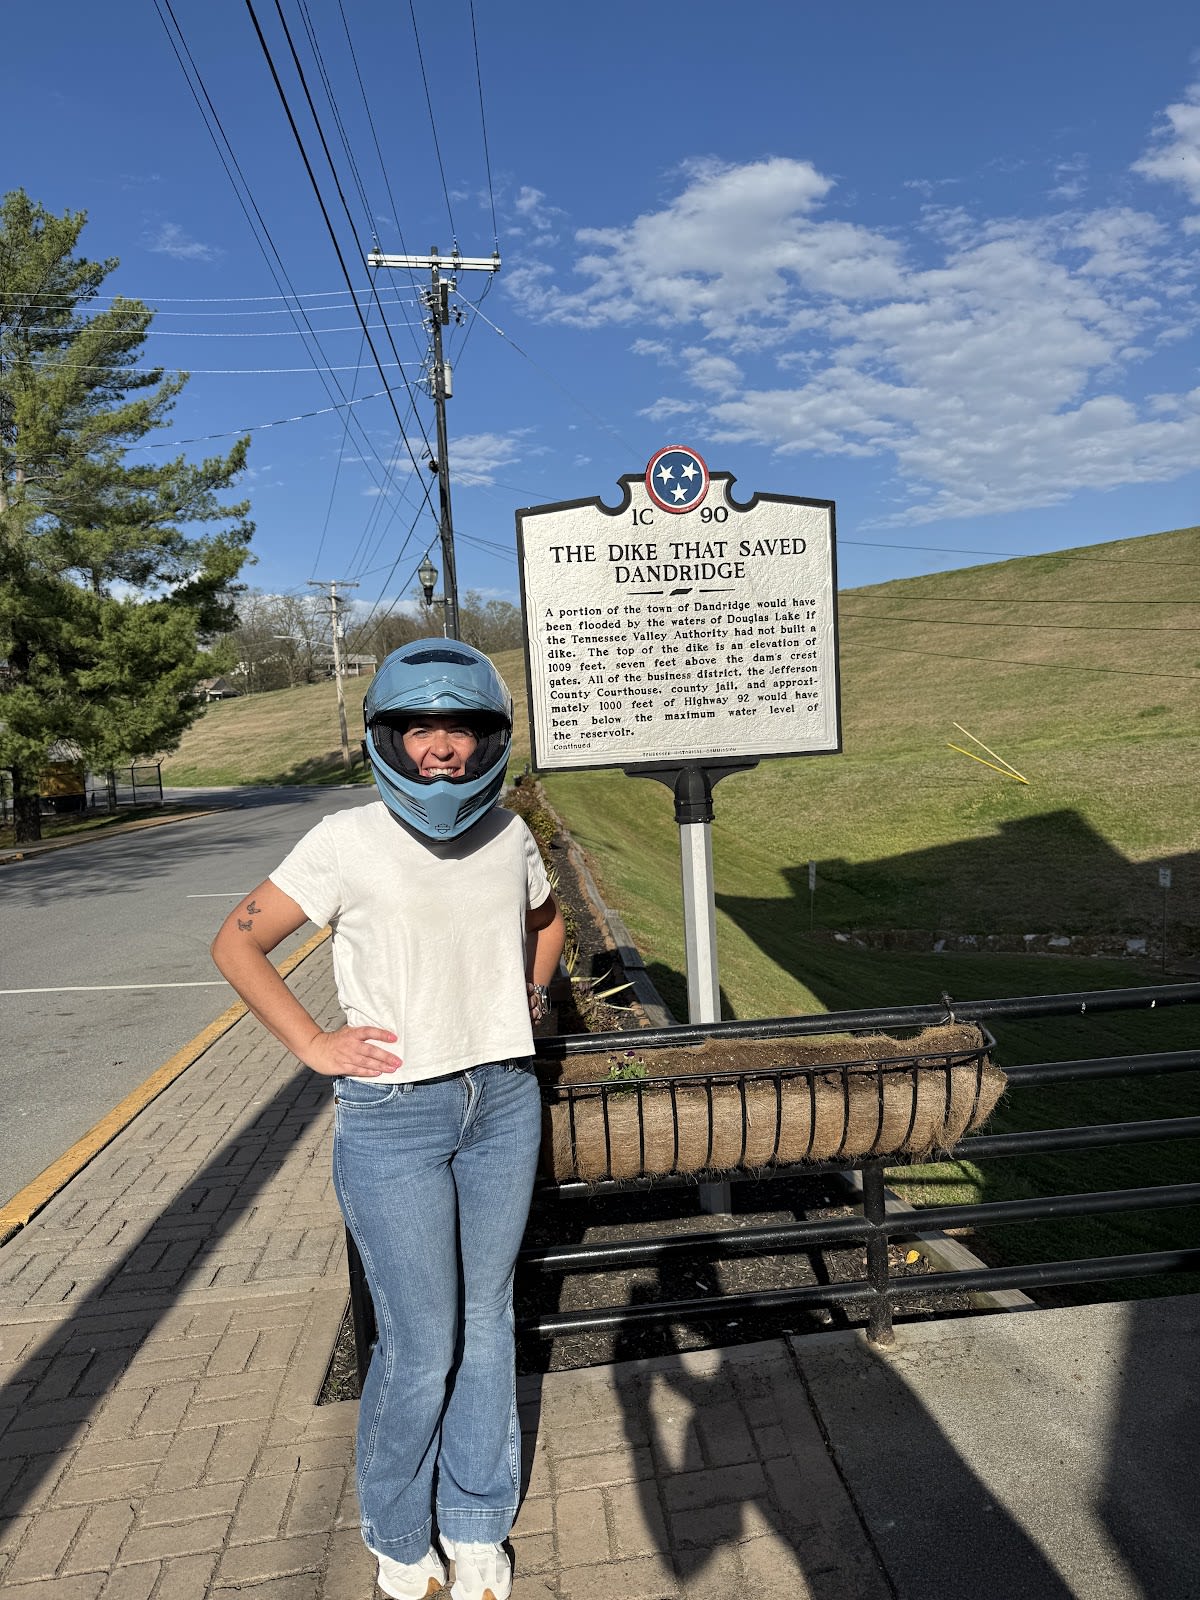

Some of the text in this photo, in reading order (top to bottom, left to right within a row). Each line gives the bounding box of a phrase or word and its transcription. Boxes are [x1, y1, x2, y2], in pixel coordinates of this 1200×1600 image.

[700, 506, 728, 523] 90
[550, 538, 806, 563] THE DIKE THAT SAVED
[616, 562, 745, 583] DANDRIDGE
[546, 608, 553, 617] A
[559, 608, 602, 618] portion
[607, 606, 619, 615] of
[624, 605, 641, 614] the
[647, 605, 672, 613] town
[694, 600, 750, 611] Dandridge
[757, 599, 787, 608] would
[793, 598, 815, 606] have
[546, 622, 572, 631] been
[579, 620, 621, 630] flooded
[628, 620, 640, 629] by
[672, 616, 705, 625] waters
[727, 614, 769, 623] Douglas
[775, 612, 800, 621] Lake
[807, 611, 816, 619] if
[548, 636, 565, 644] the
[571, 634, 627, 643] Tennessee
[633, 632, 667, 641] Valley
[674, 628, 728, 639] Authority
[735, 627, 753, 636] had
[758, 626, 775, 634] not
[781, 625, 805, 633] built
[548, 650, 576, 659] dike.
[588, 648, 609, 656] The
[617, 647, 634, 656] top
[642, 646, 654, 654] of
[662, 645, 678, 653] the
[686, 643, 709, 652] dike
[750, 639, 799, 648] elevation
[805, 638, 816, 646] of
[548, 663, 571, 672] 1009
[616, 661, 645, 669] seven
[655, 659, 676, 667] feet
[685, 656, 716, 665] above
[726, 655, 743, 663] the
[753, 653, 782, 662] dam's
[791, 651, 817, 659] crest
[549, 677, 581, 688] gates.
[588, 676, 603, 684] All
[608, 675, 619, 683] of
[624, 674, 641, 682] the
[647, 672, 691, 681] business
[747, 667, 765, 675] the
[769, 665, 817, 674] Jefferson
[550, 690, 591, 700] County
[672, 684, 708, 693] county
[747, 680, 766, 689] and
[773, 677, 818, 688] approxi-
[551, 690, 818, 712] mately 1000 feet of Highway 92 would have
[552, 703, 818, 727] been below the maximum water level of
[553, 729, 634, 740] the reservoir.
